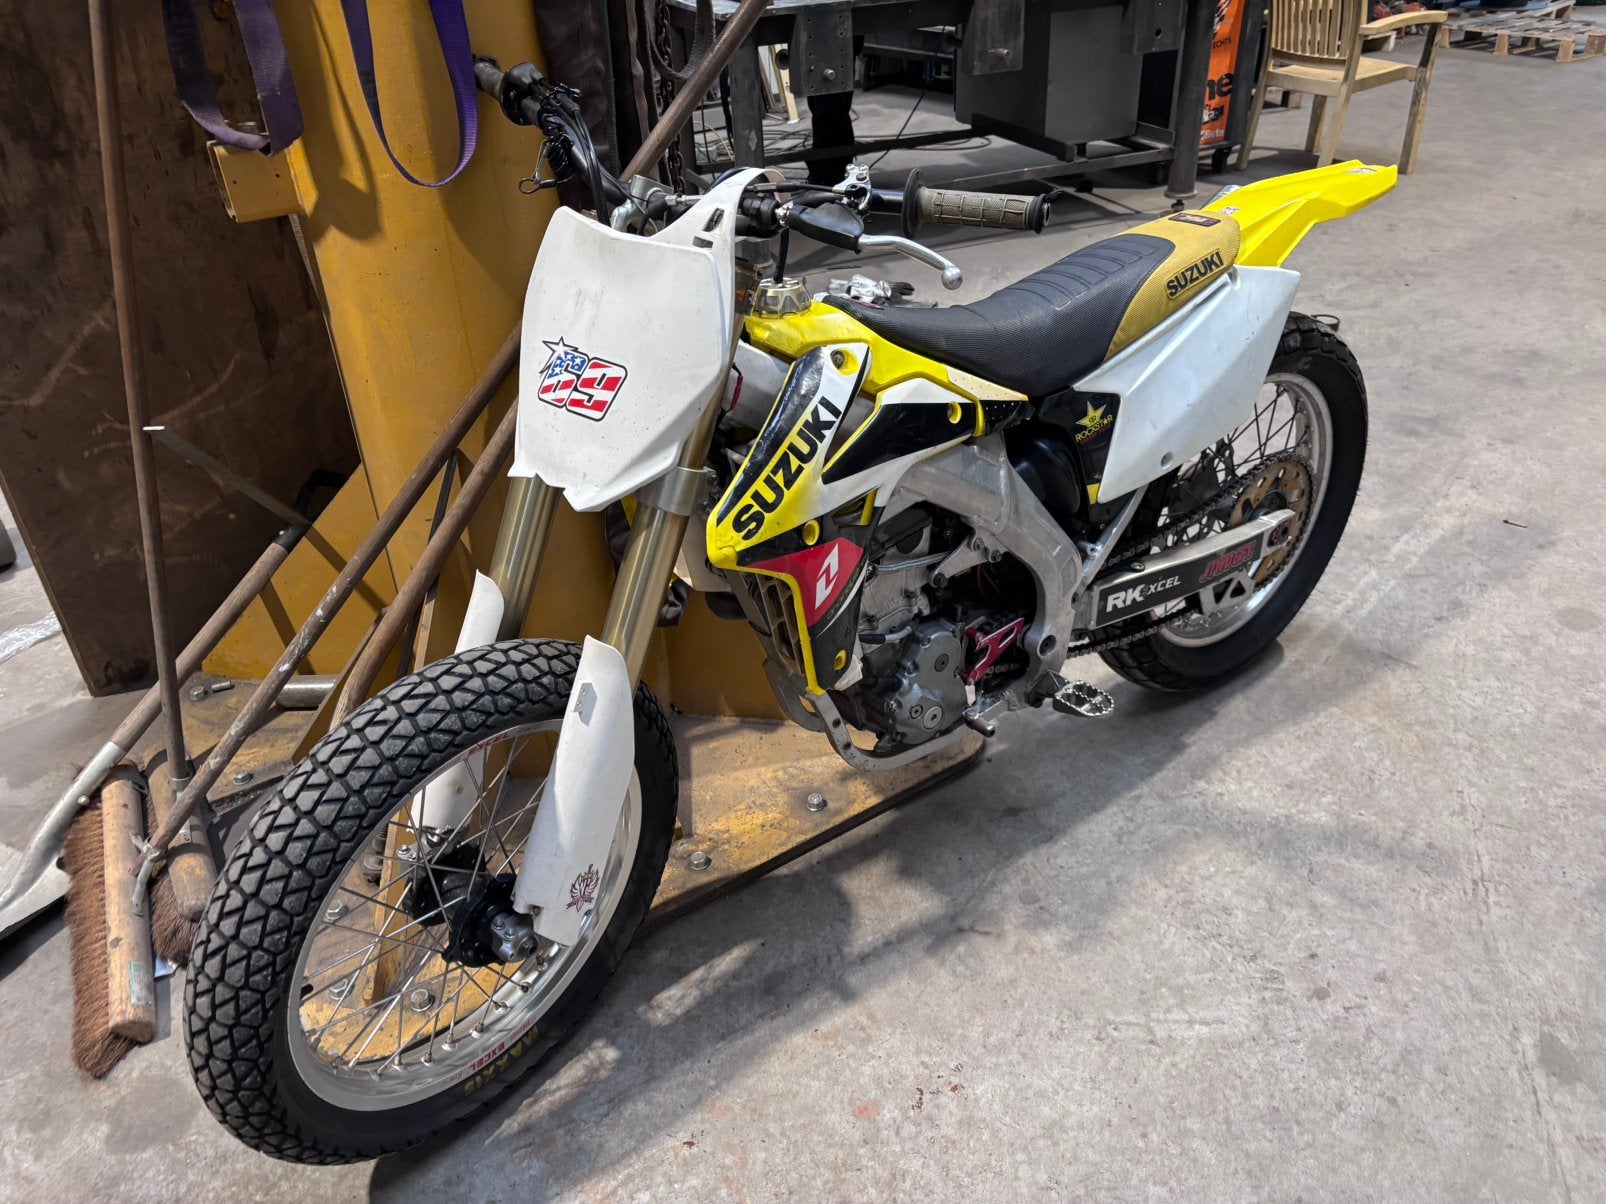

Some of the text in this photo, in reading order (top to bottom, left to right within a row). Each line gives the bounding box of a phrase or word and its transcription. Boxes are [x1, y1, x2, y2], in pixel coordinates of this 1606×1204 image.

[1166, 251, 1225, 298] SUZUKI
[538, 347, 628, 422] 69
[732, 396, 842, 541] SUZUKI
[1106, 584, 1145, 612] RK
[469, 1042, 506, 1072] EXCEL
